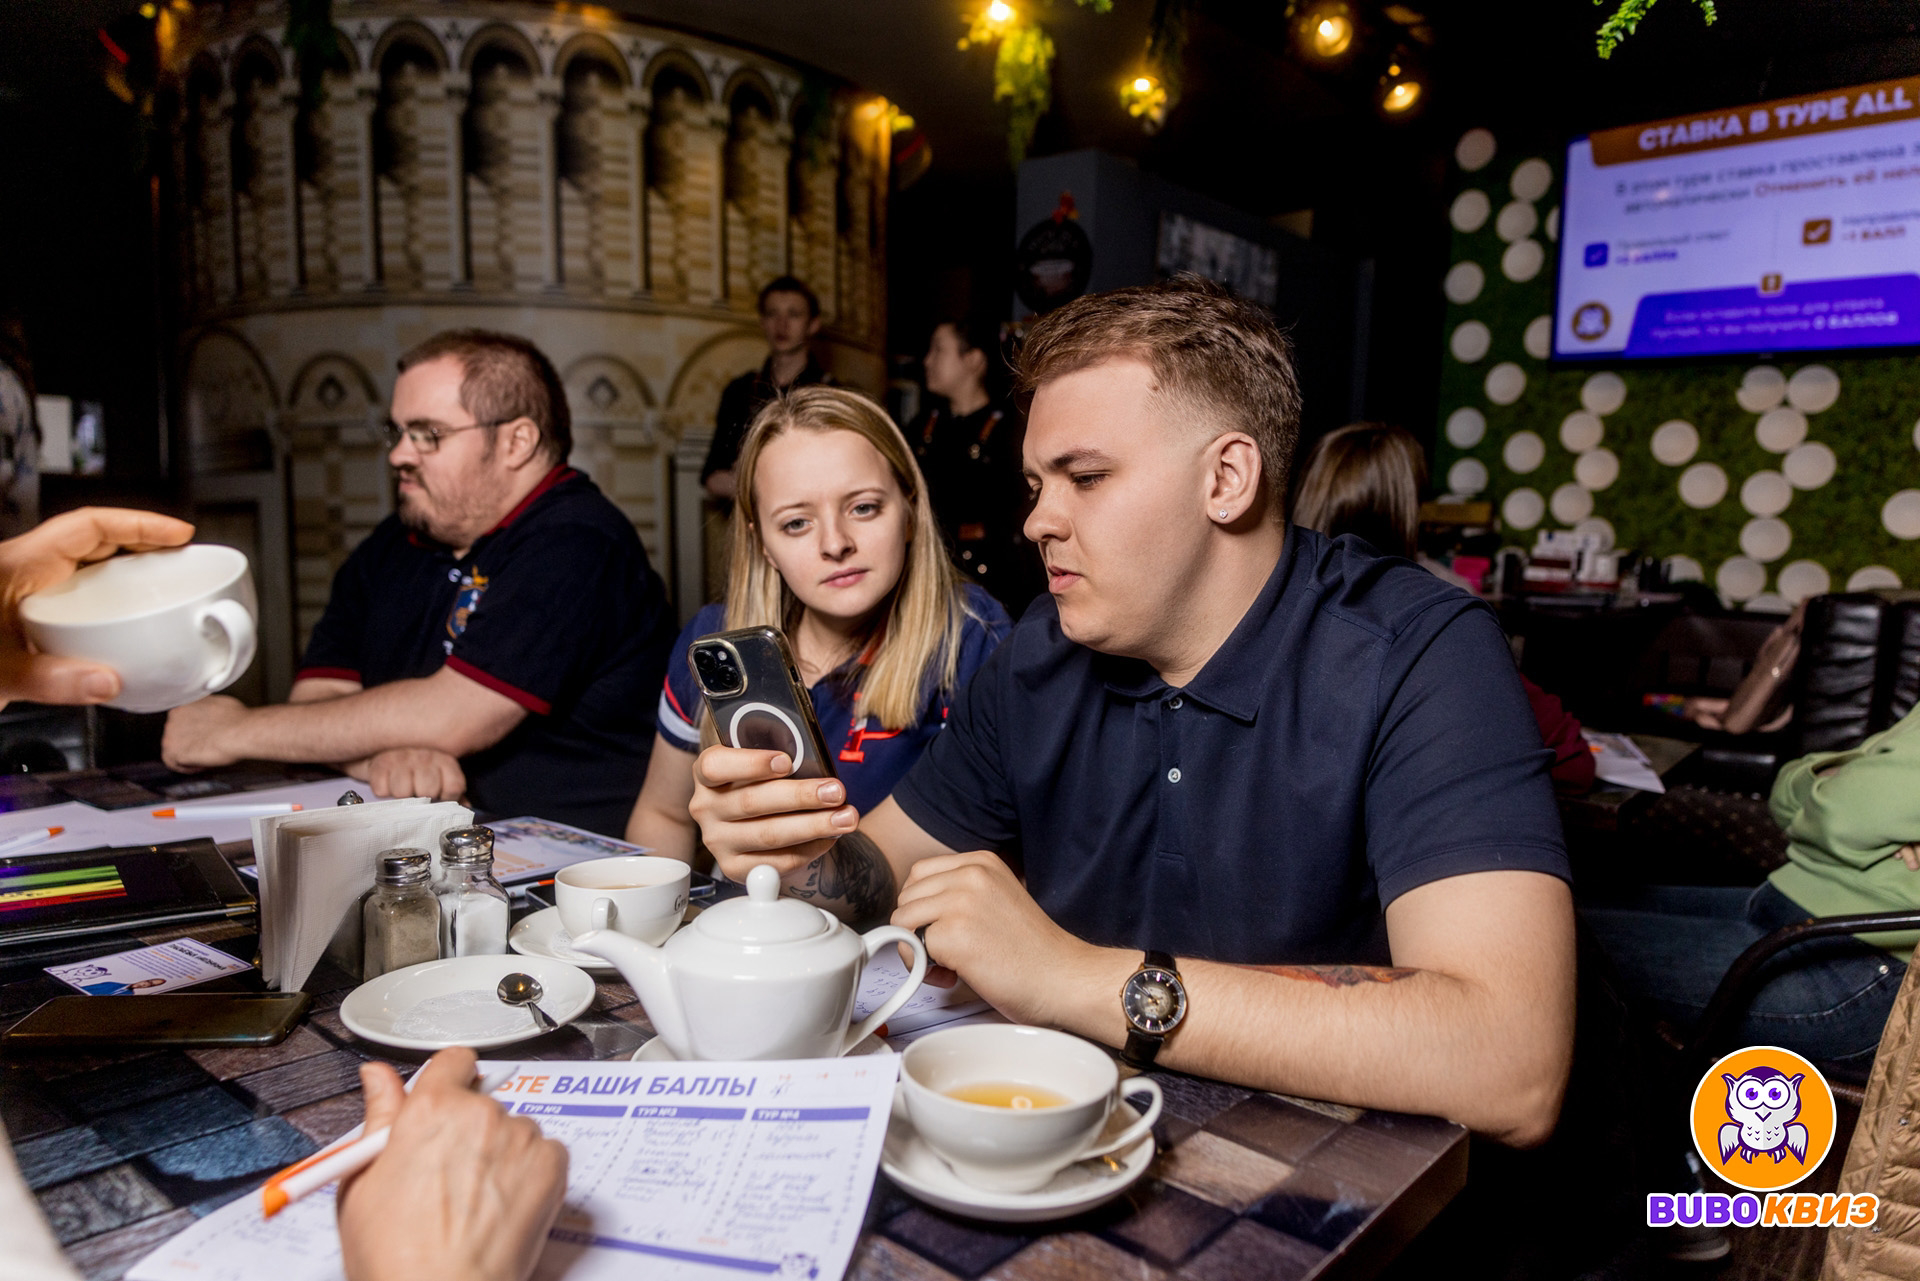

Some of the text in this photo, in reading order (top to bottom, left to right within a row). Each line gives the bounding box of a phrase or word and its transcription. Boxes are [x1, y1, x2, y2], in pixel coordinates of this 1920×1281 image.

[1638, 85, 1913, 151] СТАВКА В ТУРЕ ALL
[552, 1076, 643, 1095] ВАШИ
[647, 1077, 757, 1097] БАЛЛЫ
[523, 1104, 543, 1113] ТУР
[637, 1107, 658, 1116] ТУР
[758, 1110, 779, 1119] ТУР
